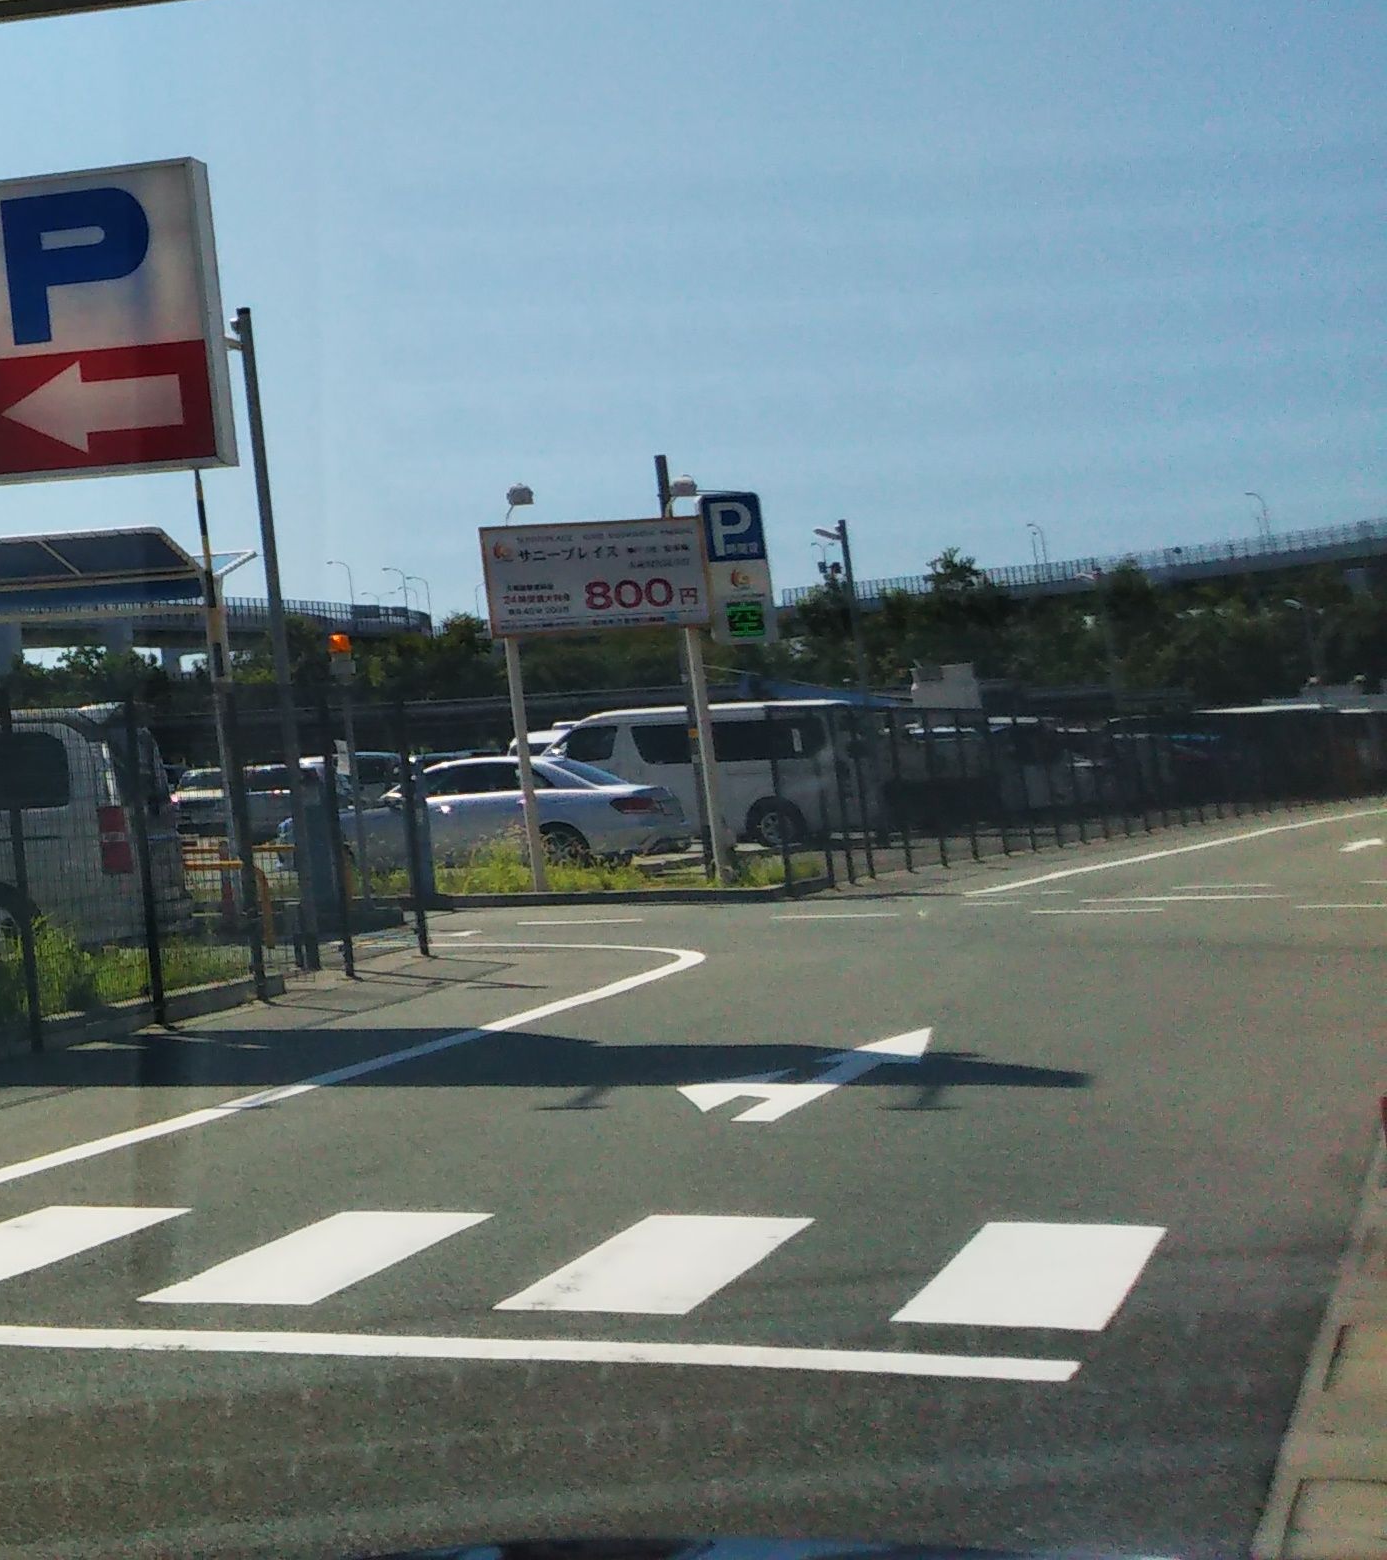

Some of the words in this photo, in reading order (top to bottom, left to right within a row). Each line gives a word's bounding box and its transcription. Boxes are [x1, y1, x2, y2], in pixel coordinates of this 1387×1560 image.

[0, 187, 150, 346] P
[709, 501, 752, 558] P
[585, 577, 674, 611] 800
